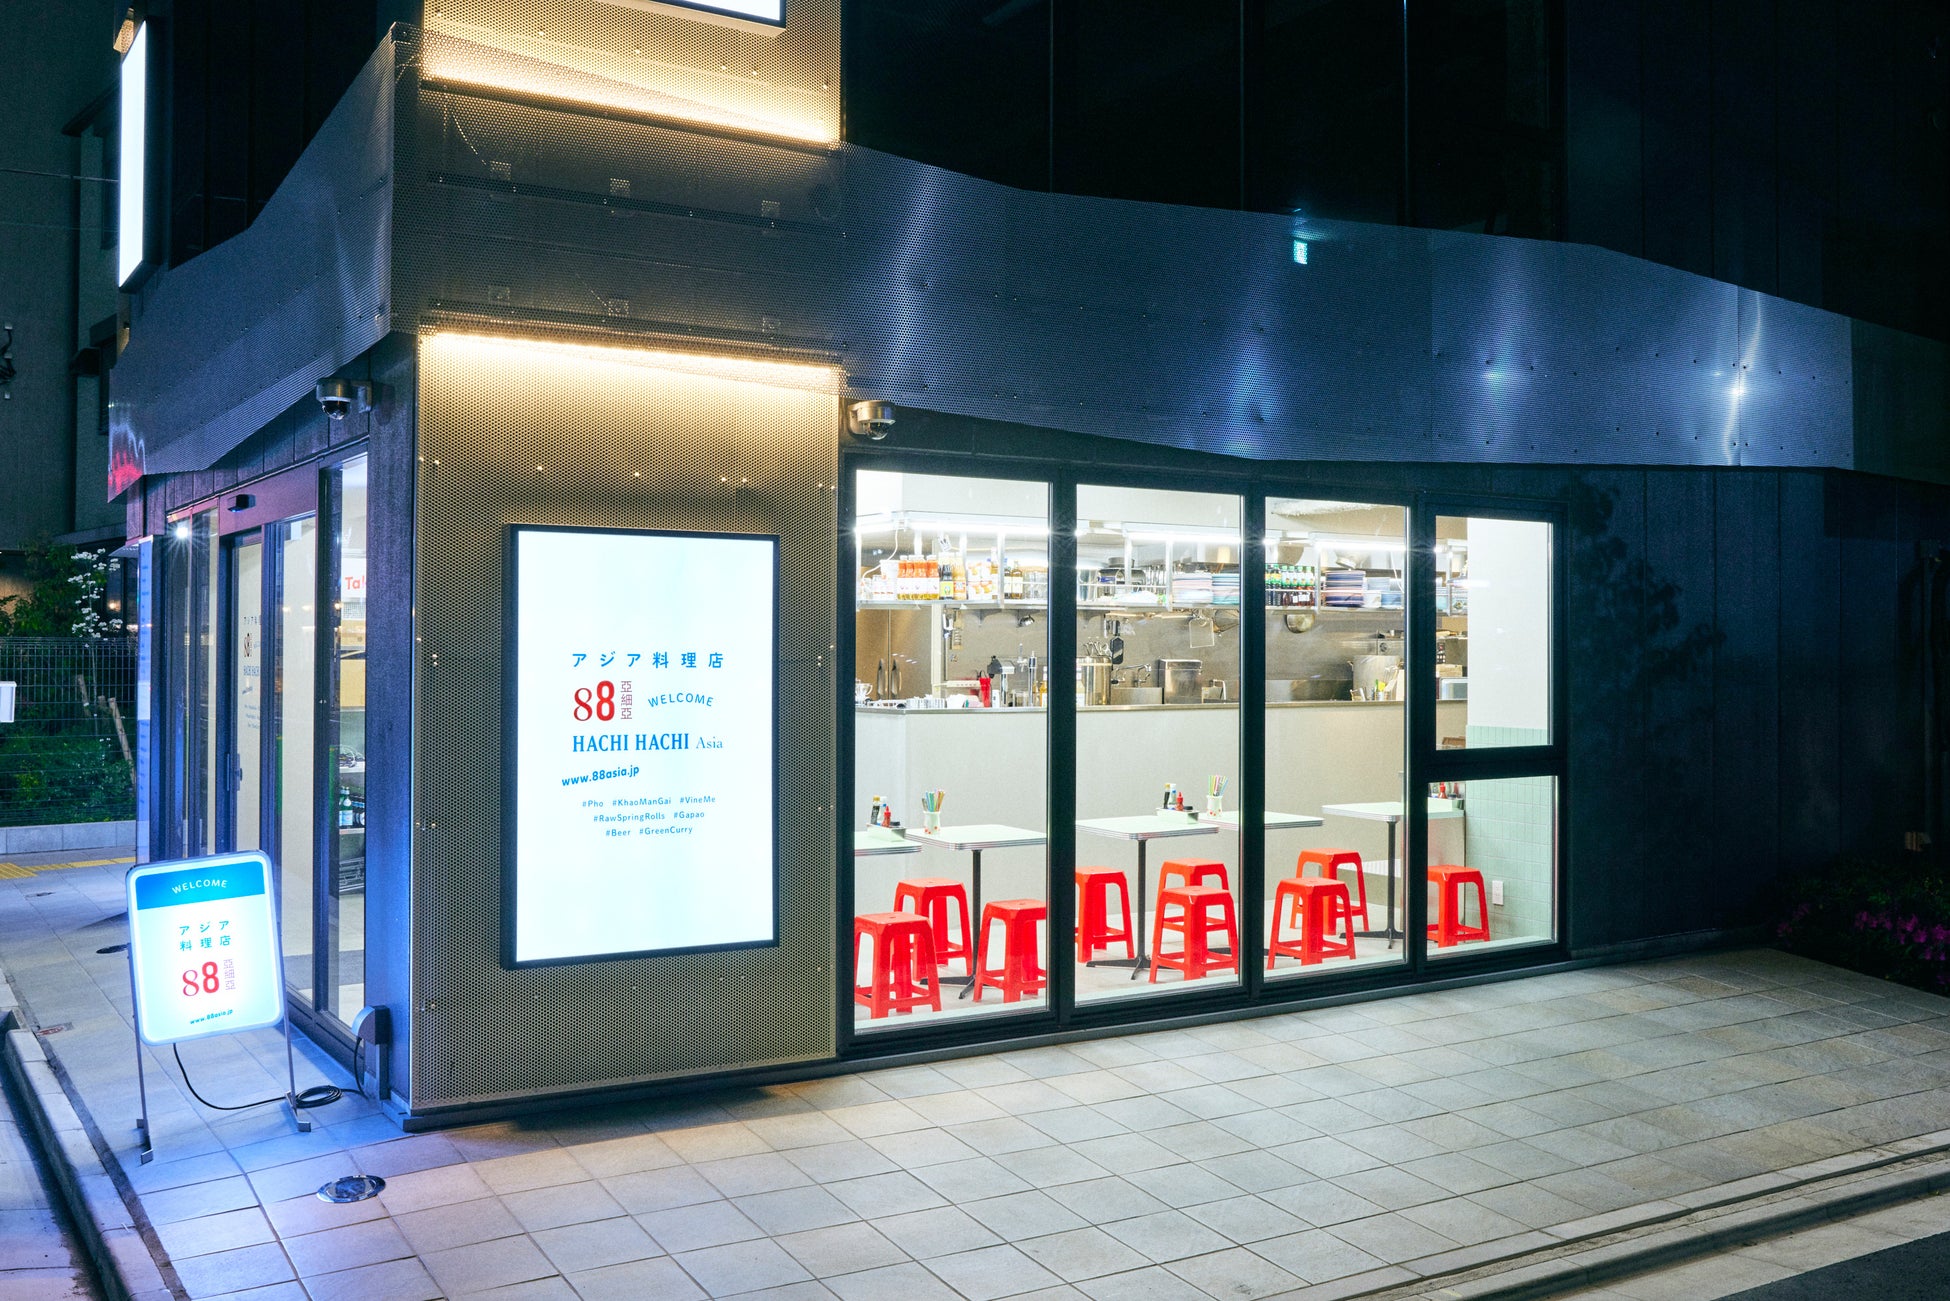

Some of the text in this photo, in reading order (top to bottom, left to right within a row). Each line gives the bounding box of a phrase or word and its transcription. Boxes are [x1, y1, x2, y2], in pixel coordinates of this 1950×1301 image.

[572, 651, 724, 669] アジア料理店
[574, 680, 615, 721] 88
[648, 693, 713, 707] WELCOME
[573, 733, 723, 752] HACHI HACHI Asia
[562, 765, 640, 786] www.88asia.jp
[582, 795, 716, 808] #Pho #KhaoManGai #VineMe
[594, 810, 705, 824] #RawSpringRolls #Gapao
[606, 825, 693, 838] #Beer #GreenCurry
[172, 880, 227, 893] WELCOME
[179, 920, 230, 935] アジア
[180, 935, 231, 951] 料理店
[182, 961, 219, 996] 88
